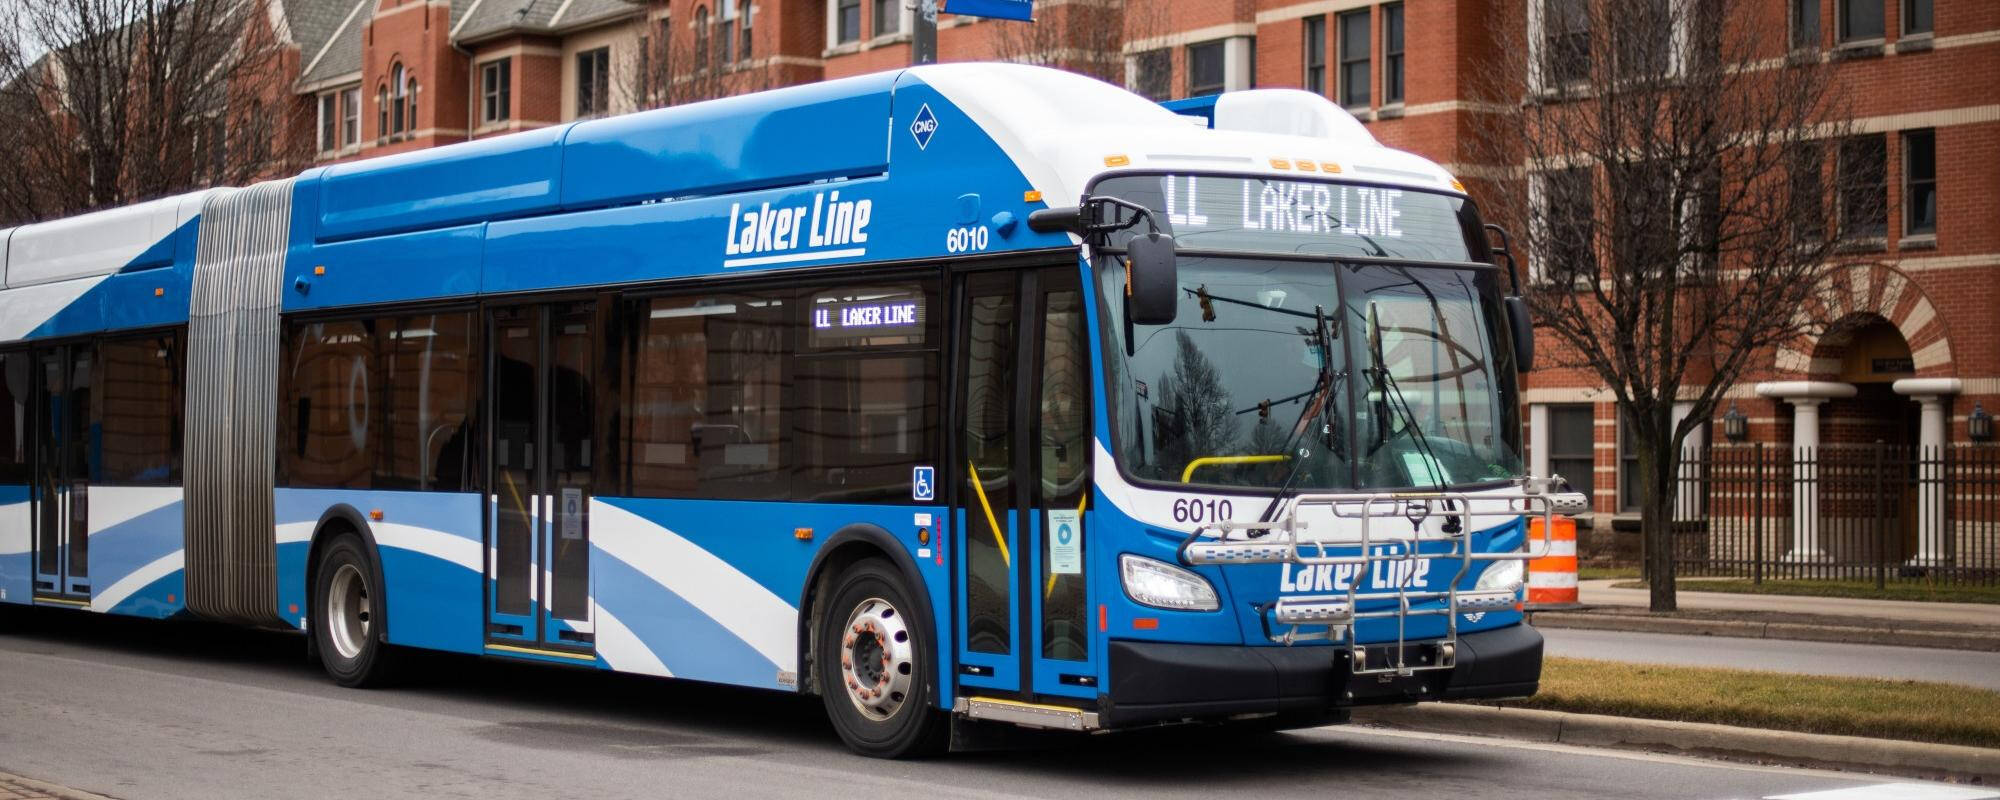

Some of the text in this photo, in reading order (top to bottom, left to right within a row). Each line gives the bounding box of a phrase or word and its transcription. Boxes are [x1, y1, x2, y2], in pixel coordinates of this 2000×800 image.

[914, 119, 934, 134] CNG
[1166, 175, 1402, 236] LL LAKER LINE
[725, 190, 873, 256] Laker Line
[947, 225, 989, 253] 6010
[816, 304, 915, 328] LL LAKER LINE
[1173, 498, 1232, 523] 6010
[1371, 545, 1430, 589] Line
